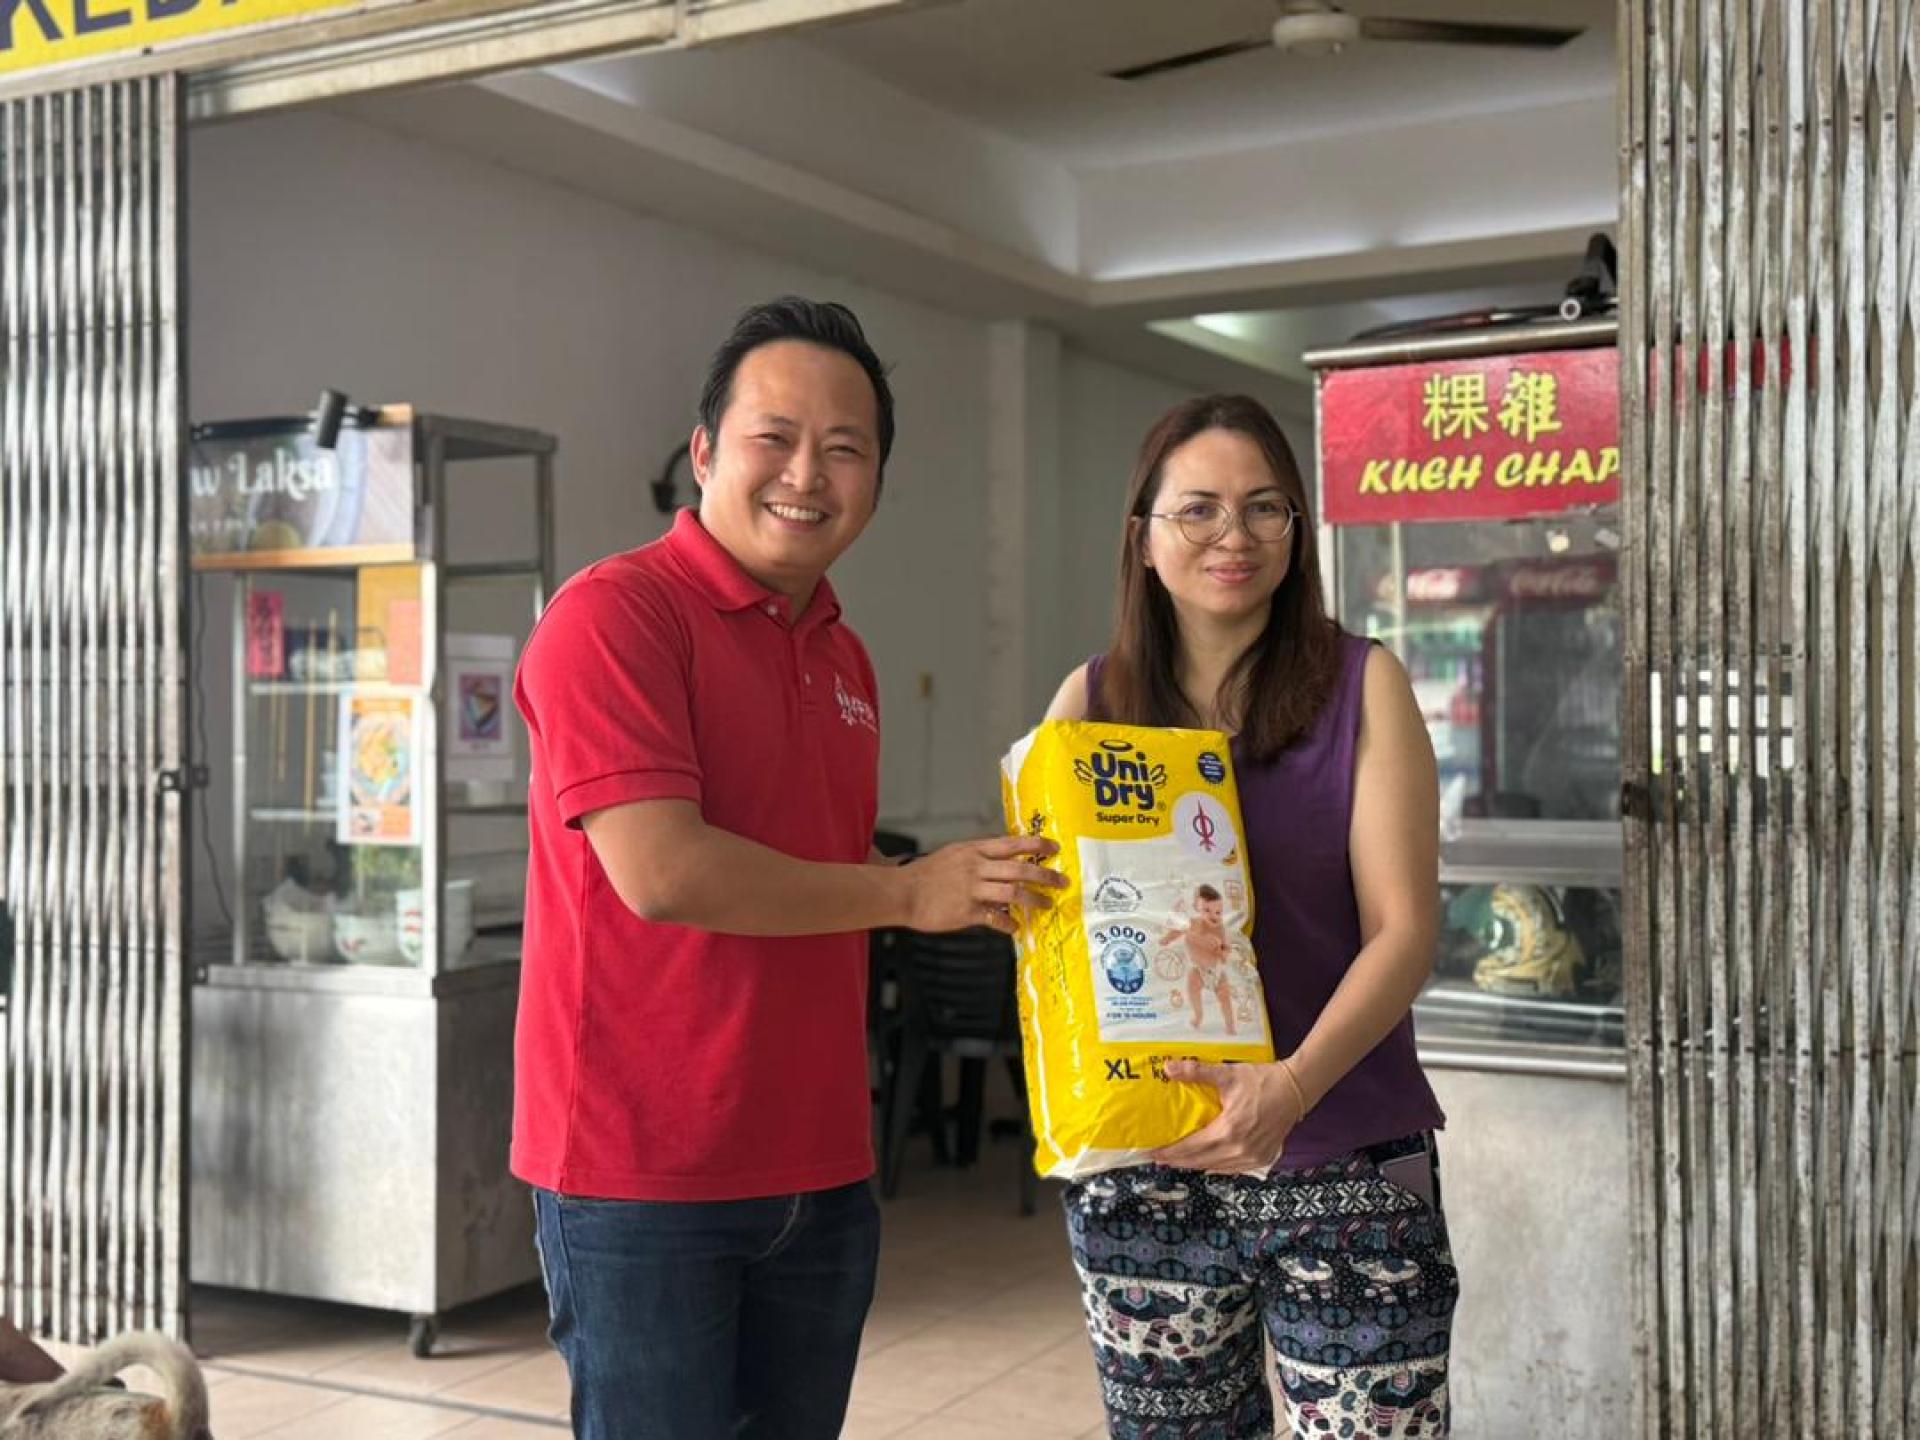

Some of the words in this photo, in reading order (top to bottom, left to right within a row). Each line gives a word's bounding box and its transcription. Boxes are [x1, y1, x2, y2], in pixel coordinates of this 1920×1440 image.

[226, 446, 335, 502] Laksa
[1359, 453, 1483, 494] KUEH
[1494, 447, 1620, 488] CHAP
[1091, 751, 1149, 783] Uni
[1095, 778, 1154, 811] Dry
[1096, 811, 1134, 825] Super
[1137, 814, 1160, 826] Dry
[1104, 1057, 1141, 1081] XL
